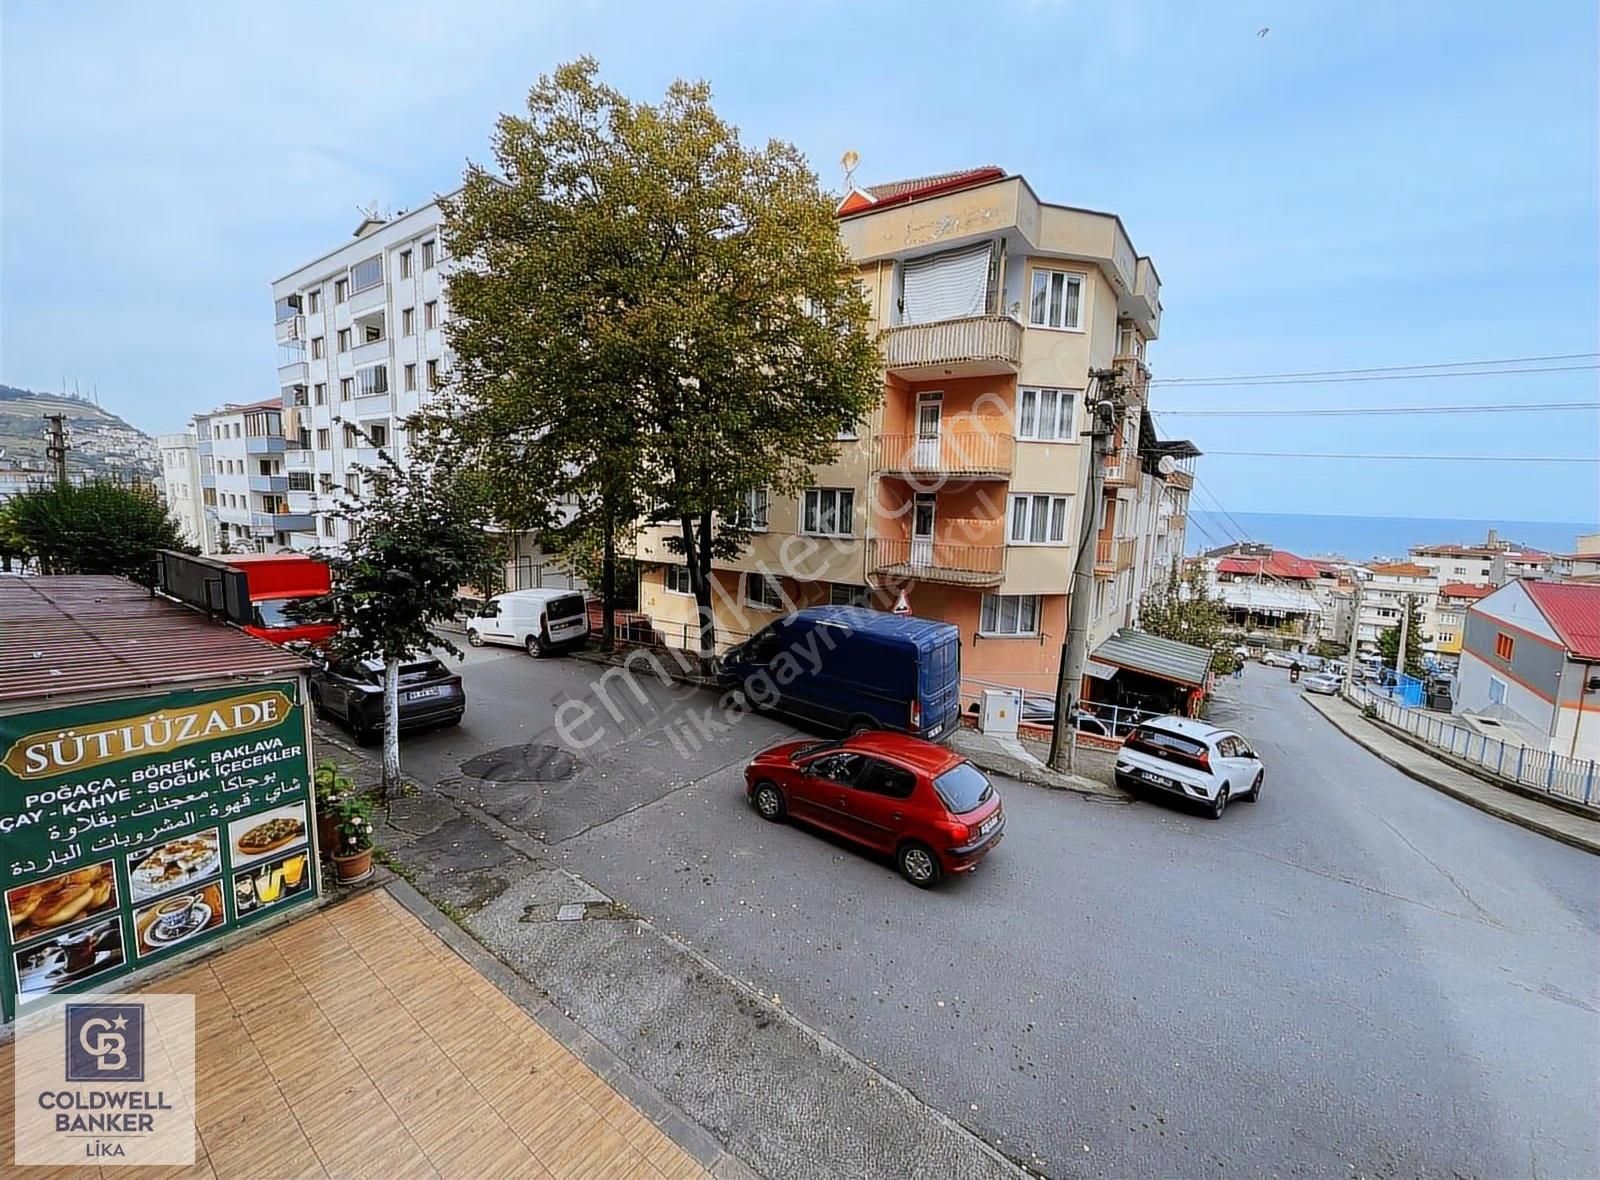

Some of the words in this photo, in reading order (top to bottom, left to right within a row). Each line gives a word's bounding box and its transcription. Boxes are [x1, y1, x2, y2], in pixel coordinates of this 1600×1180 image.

[24, 698, 279, 773] SÜTLÜZADE
[0, 809, 43, 833] ÇAY
[62, 788, 132, 815] KAHVE
[147, 767, 211, 793] SOĞUK
[215, 746, 302, 777] İÇECEKLER
[25, 777, 116, 808] POĞAÇA
[131, 757, 196, 783] BÖREK
[210, 738, 283, 763] BAKLAVA
[131, 790, 209, 817] معجنات
[208, 791, 251, 818] قهوة
[265, 778, 301, 803] شاي
[48, 811, 117, 841] بقلاوة
[91, 811, 195, 852] المشروبات
[10, 843, 81, 876] الباردة
